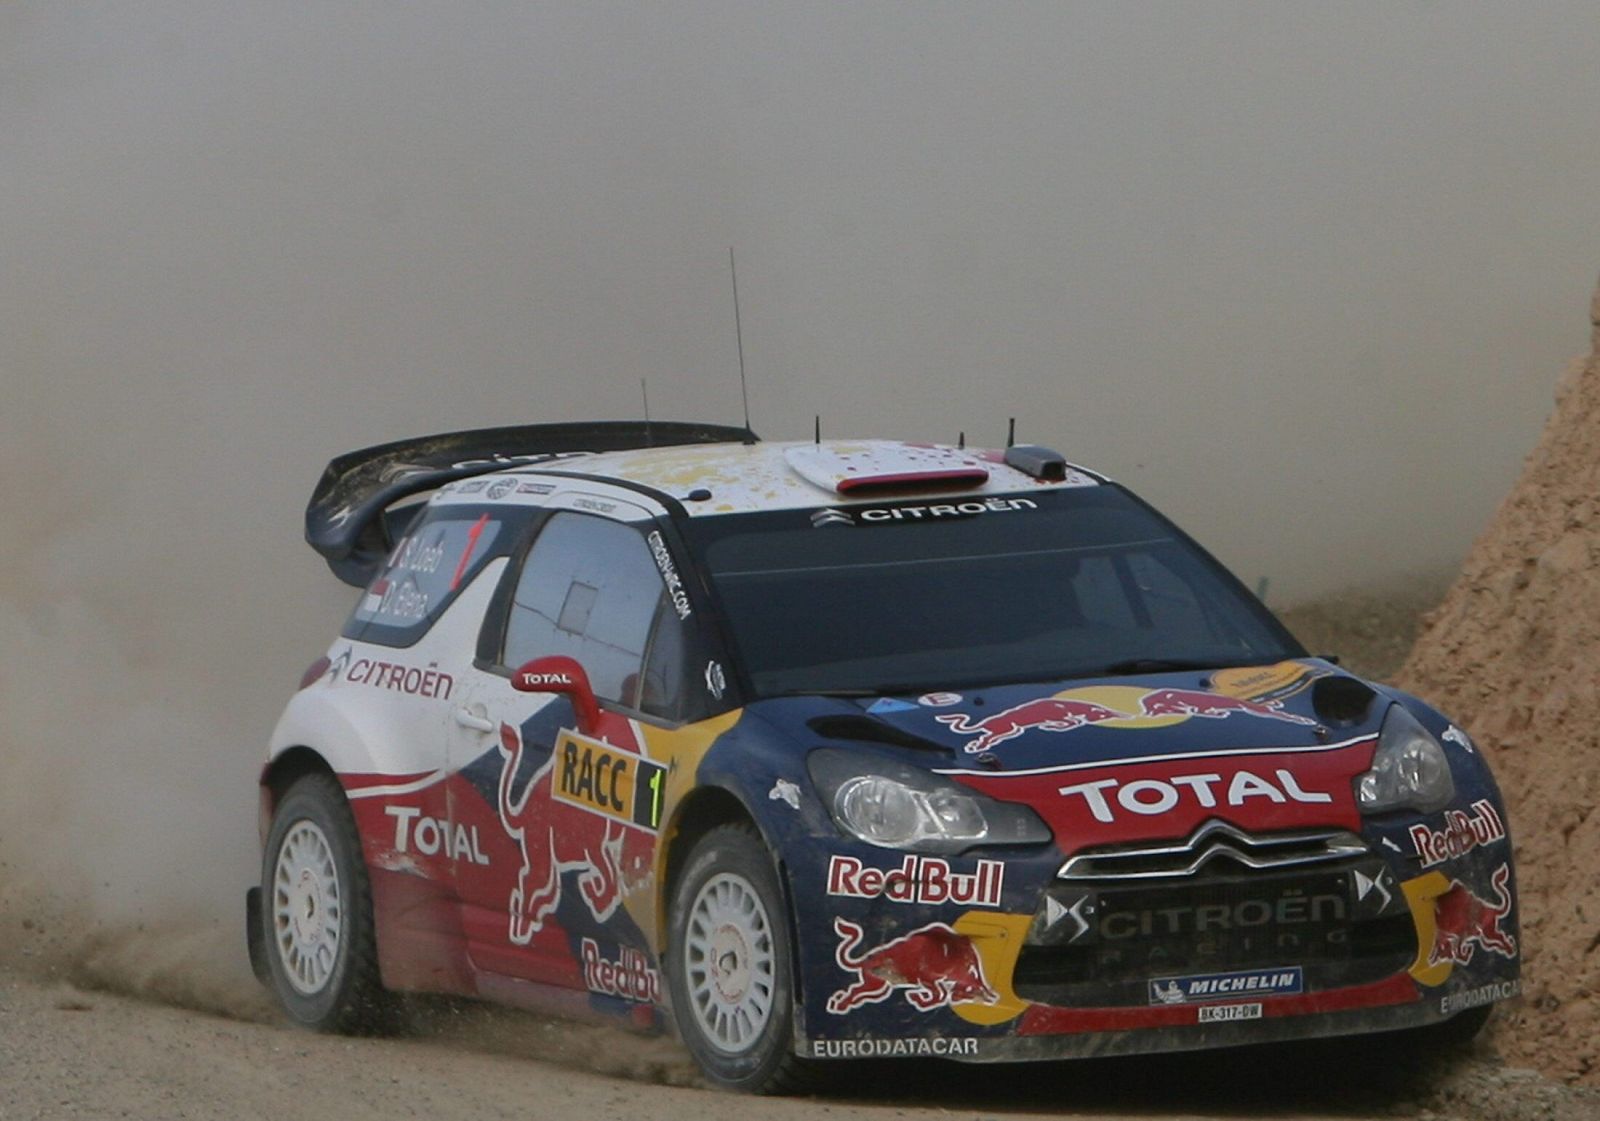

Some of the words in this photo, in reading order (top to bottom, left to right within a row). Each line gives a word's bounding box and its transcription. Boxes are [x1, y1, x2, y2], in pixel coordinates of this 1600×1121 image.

[347, 660, 453, 700] CITROËN
[522, 671, 573, 685] TOTAL
[562, 741, 627, 812] RACC
[649, 768, 661, 828] 1
[1059, 769, 1332, 822] TOTAL
[385, 805, 489, 865] TOTAL
[1189, 973, 1294, 994] MICHELIN
[813, 1038, 978, 1058] EURODATACAR
